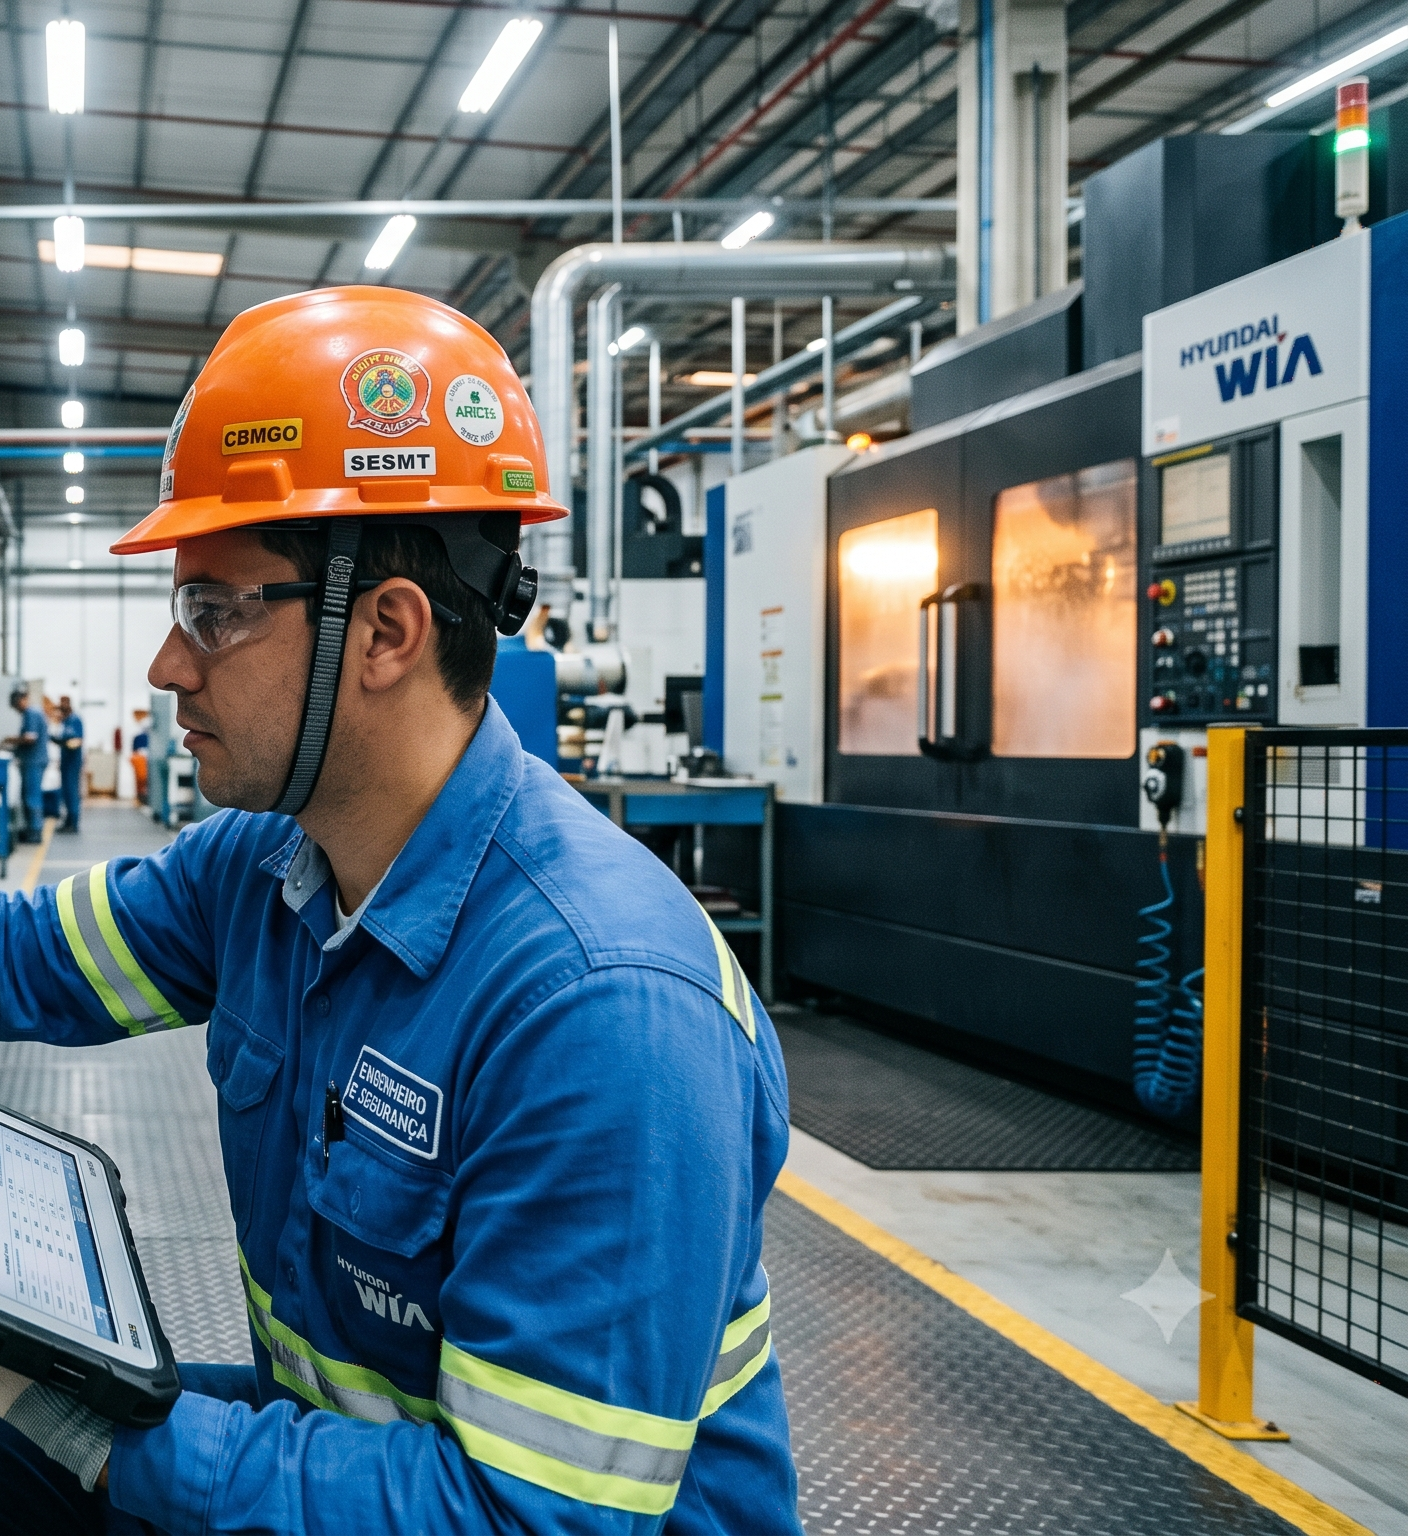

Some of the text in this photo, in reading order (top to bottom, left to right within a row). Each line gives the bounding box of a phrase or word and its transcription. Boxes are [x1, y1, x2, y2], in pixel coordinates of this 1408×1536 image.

[1180, 313, 1279, 367] HYUNDAI
[1215, 332, 1323, 403] WIA
[224, 425, 298, 448] CBMGO
[350, 453, 430, 471] SESMT
[348, 1081, 428, 1143] E SEGURANÇA
[358, 1061, 427, 1115] ENGENHEIRO
